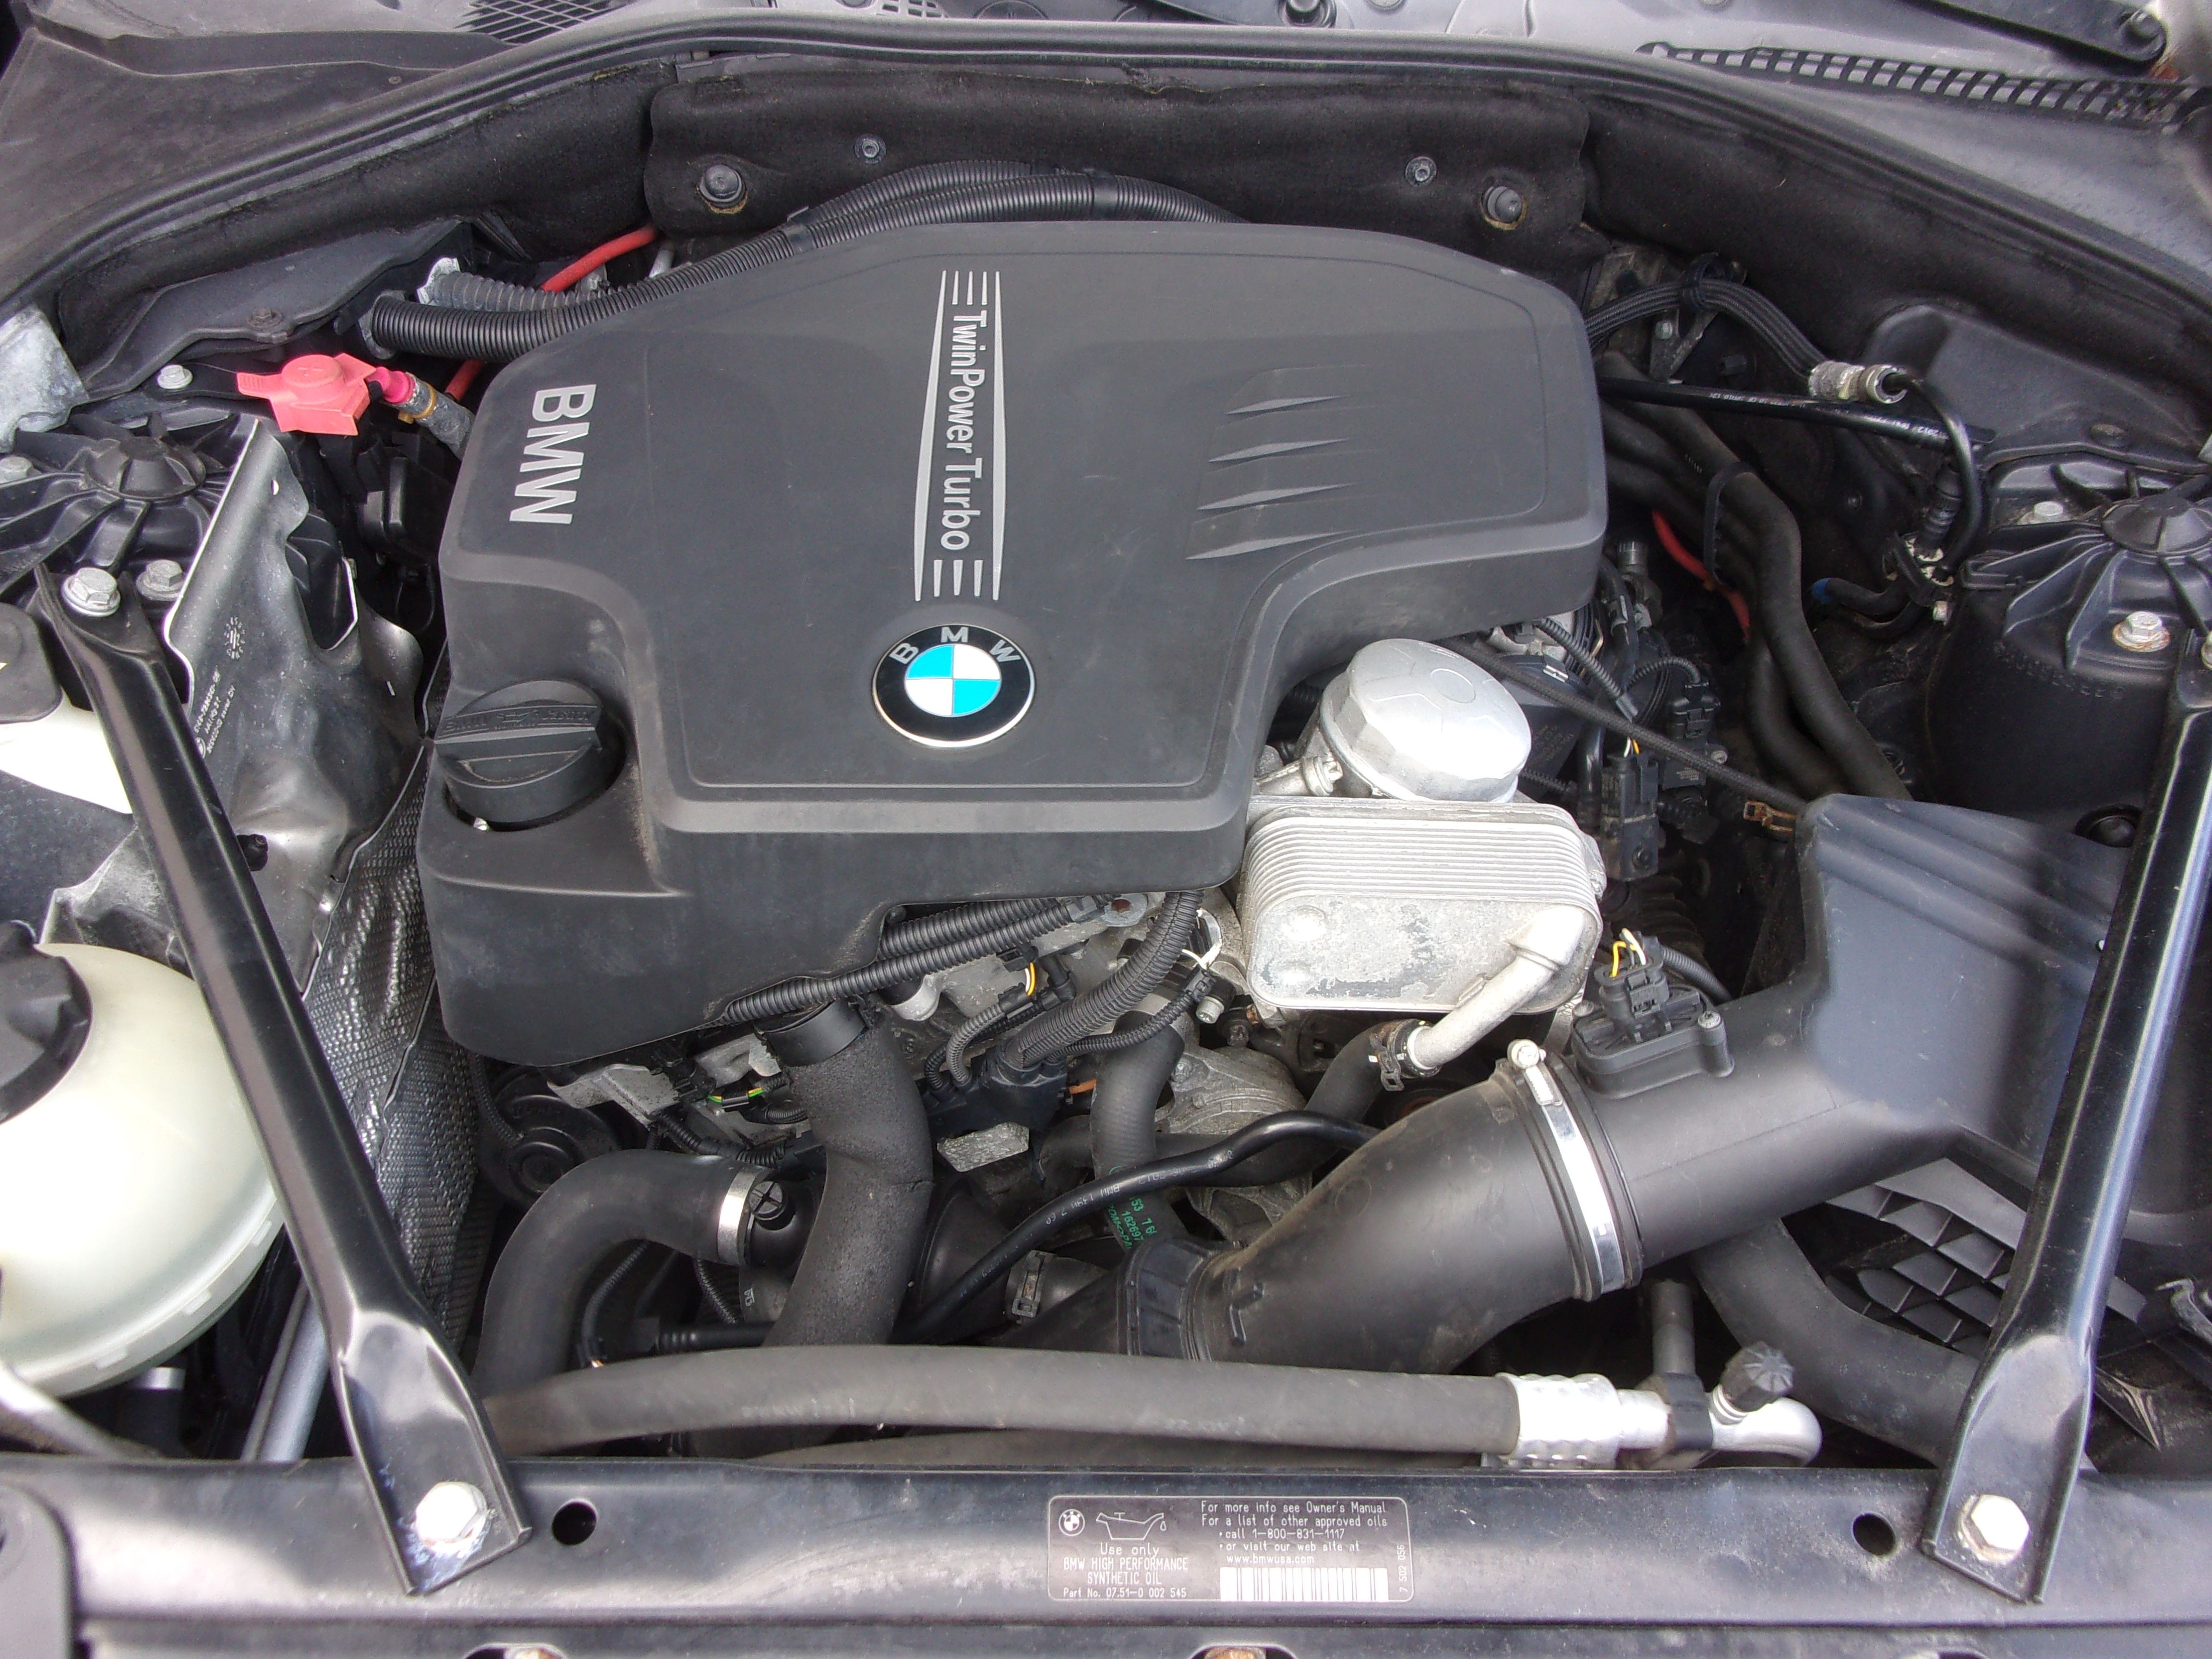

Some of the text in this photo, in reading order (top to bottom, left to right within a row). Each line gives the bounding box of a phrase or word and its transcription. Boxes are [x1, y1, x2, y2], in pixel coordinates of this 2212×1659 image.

[940, 310, 987, 550] TwinPower Turbo
[509, 384, 597, 524] BMW
[889, 626, 1022, 665] BMW
[1201, 1501, 1386, 1513] For more info see Owner's Manual
[1202, 1514, 1387, 1529] For a list of other approved oils
[1226, 1527, 1345, 1539] call 1-800-831-1117
[1100, 1542, 1159, 1559] Use only
[1243, 1540, 1267, 1551] visit
[1297, 1541, 1316, 1552] web
[1323, 1540, 1343, 1551] site
[1349, 1540, 1360, 1551] at
[1064, 1557, 1189, 1571] BMW HIGH PERFORMANCE
[1226, 1552, 1314, 1564] www.bmwusa.com
[1087, 1571, 1162, 1585] SYNTHETIC OIL
[1398, 1565, 1407, 1582] 502
[1063, 1587, 1081, 1598] Part
[1087, 1587, 1101, 1598] No.
[1149, 1587, 1165, 1598] 002
[1170, 1587, 1187, 1598] 545
